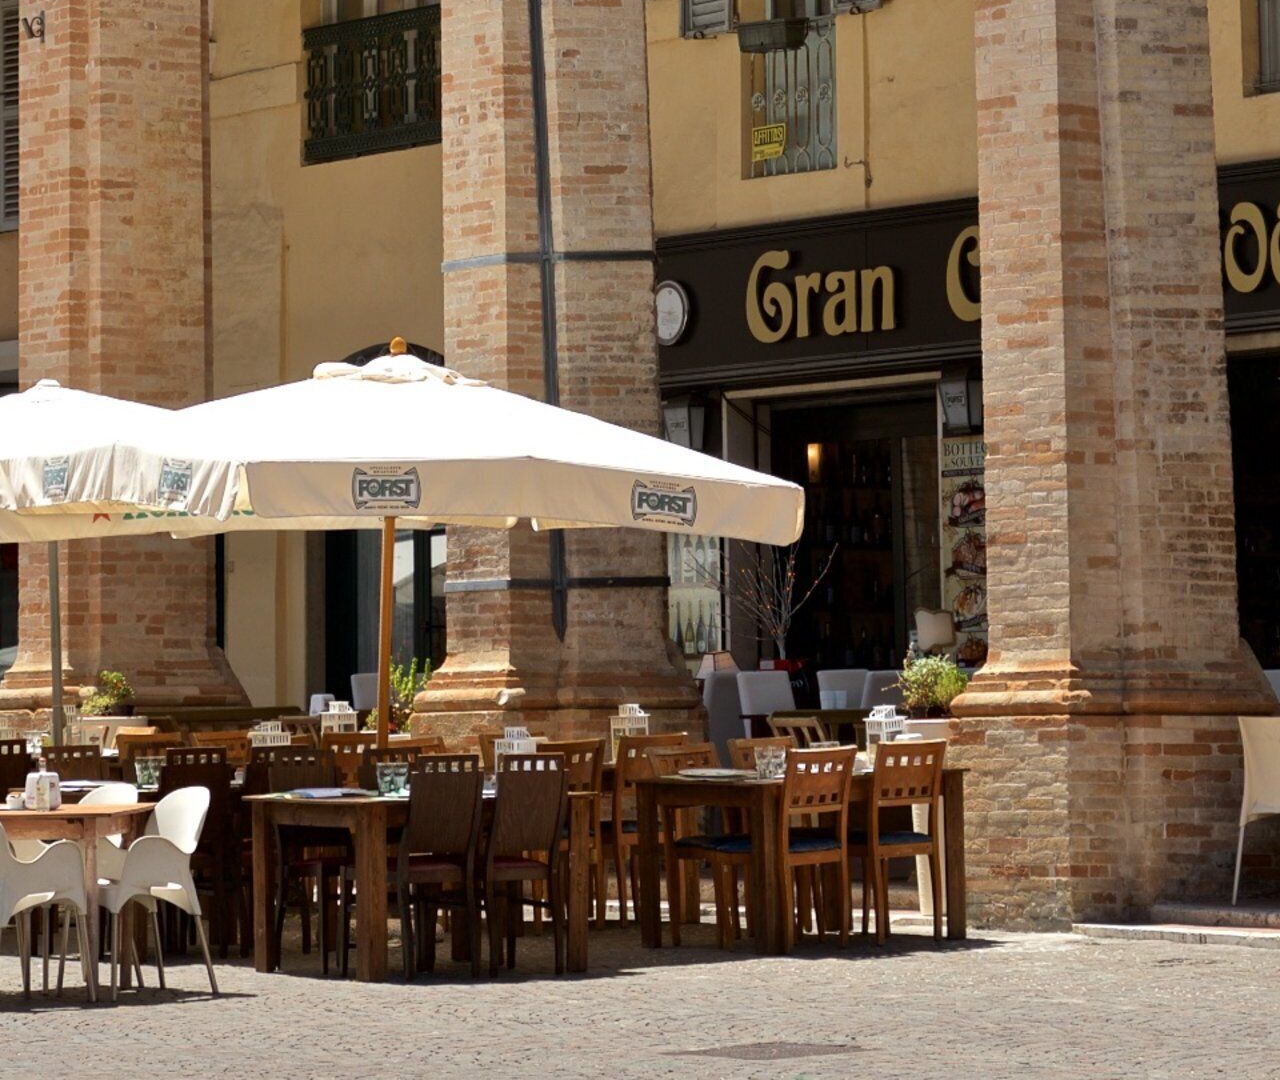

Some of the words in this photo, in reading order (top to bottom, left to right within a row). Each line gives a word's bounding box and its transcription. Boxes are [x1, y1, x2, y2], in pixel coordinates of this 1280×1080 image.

[745, 249, 897, 344] Gran
[358, 479, 414, 498] FORST
[637, 491, 692, 515] FORST
